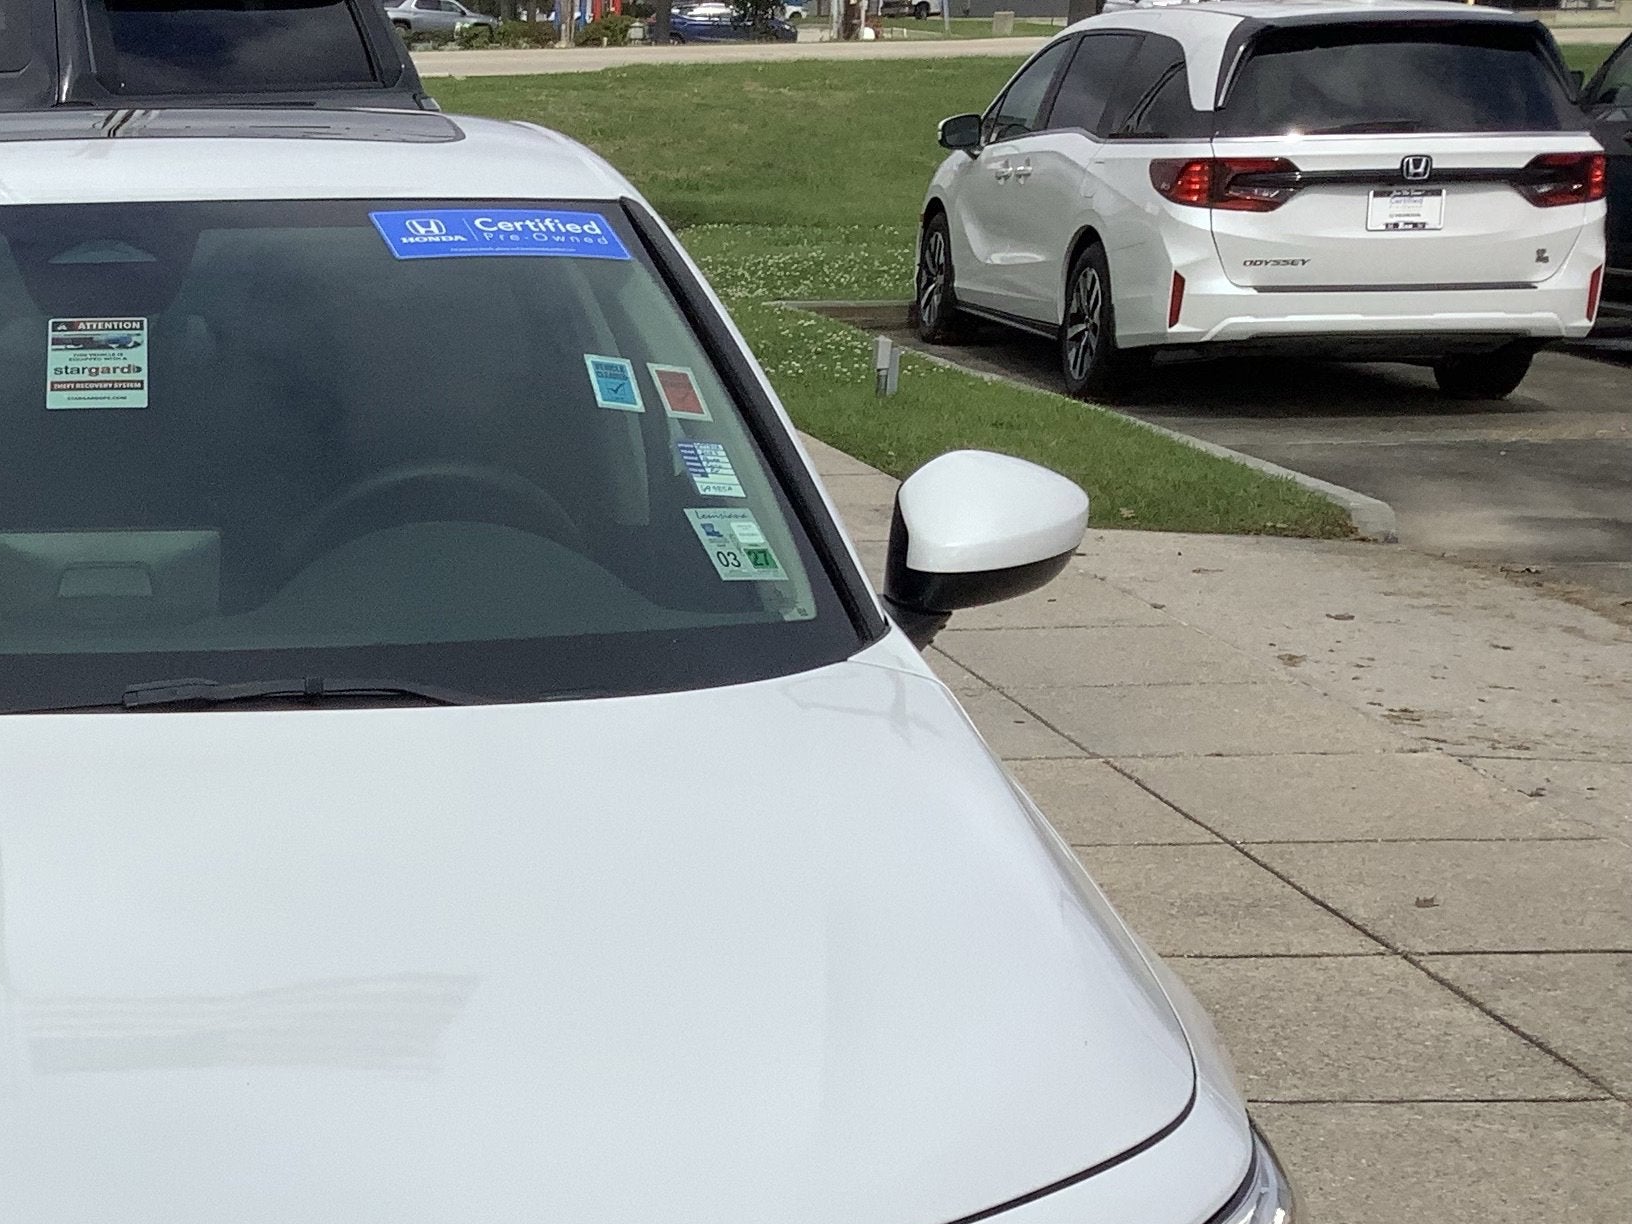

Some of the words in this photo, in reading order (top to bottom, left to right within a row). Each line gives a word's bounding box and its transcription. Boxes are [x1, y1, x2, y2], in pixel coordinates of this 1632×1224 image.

[473, 217, 603, 235] Certified
[400, 234, 468, 244] HONDA
[483, 233, 609, 245] Pre-Owned
[1242, 258, 1311, 267] ODYSSEY
[77, 321, 141, 330] ATTENTION
[716, 551, 741, 568] 03
[747, 550, 770, 566] 27
